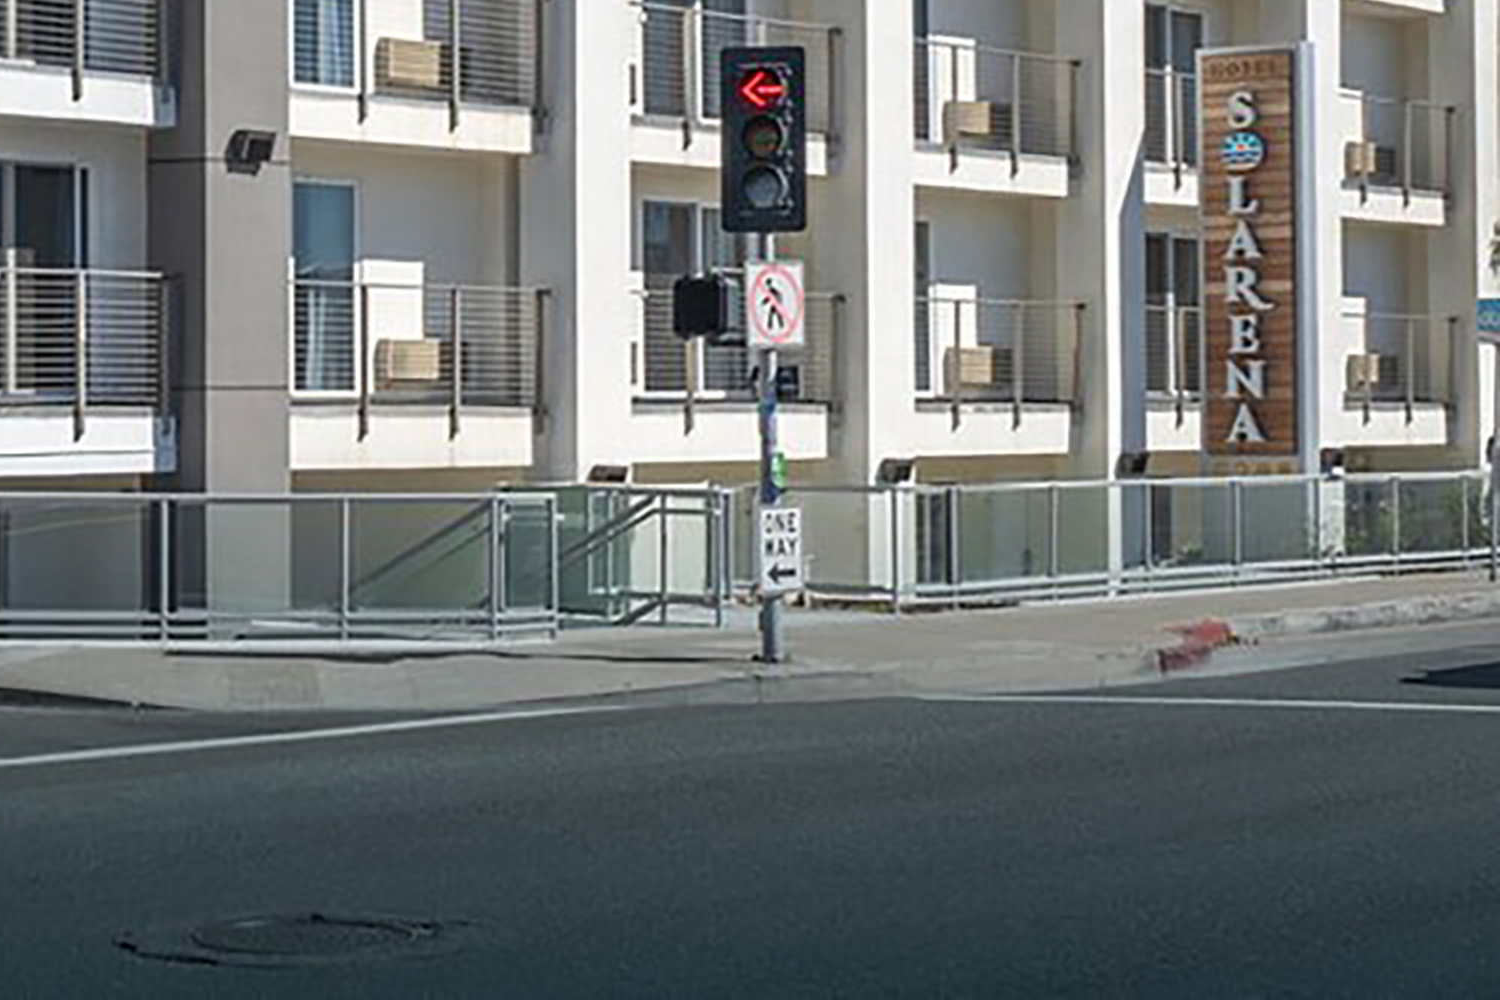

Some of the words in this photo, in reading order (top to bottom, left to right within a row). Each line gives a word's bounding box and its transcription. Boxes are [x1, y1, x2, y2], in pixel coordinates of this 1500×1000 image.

[1220, 91, 1275, 443] SOLARENA
[765, 512, 797, 533] ONE
[765, 538, 798, 556] WAY
